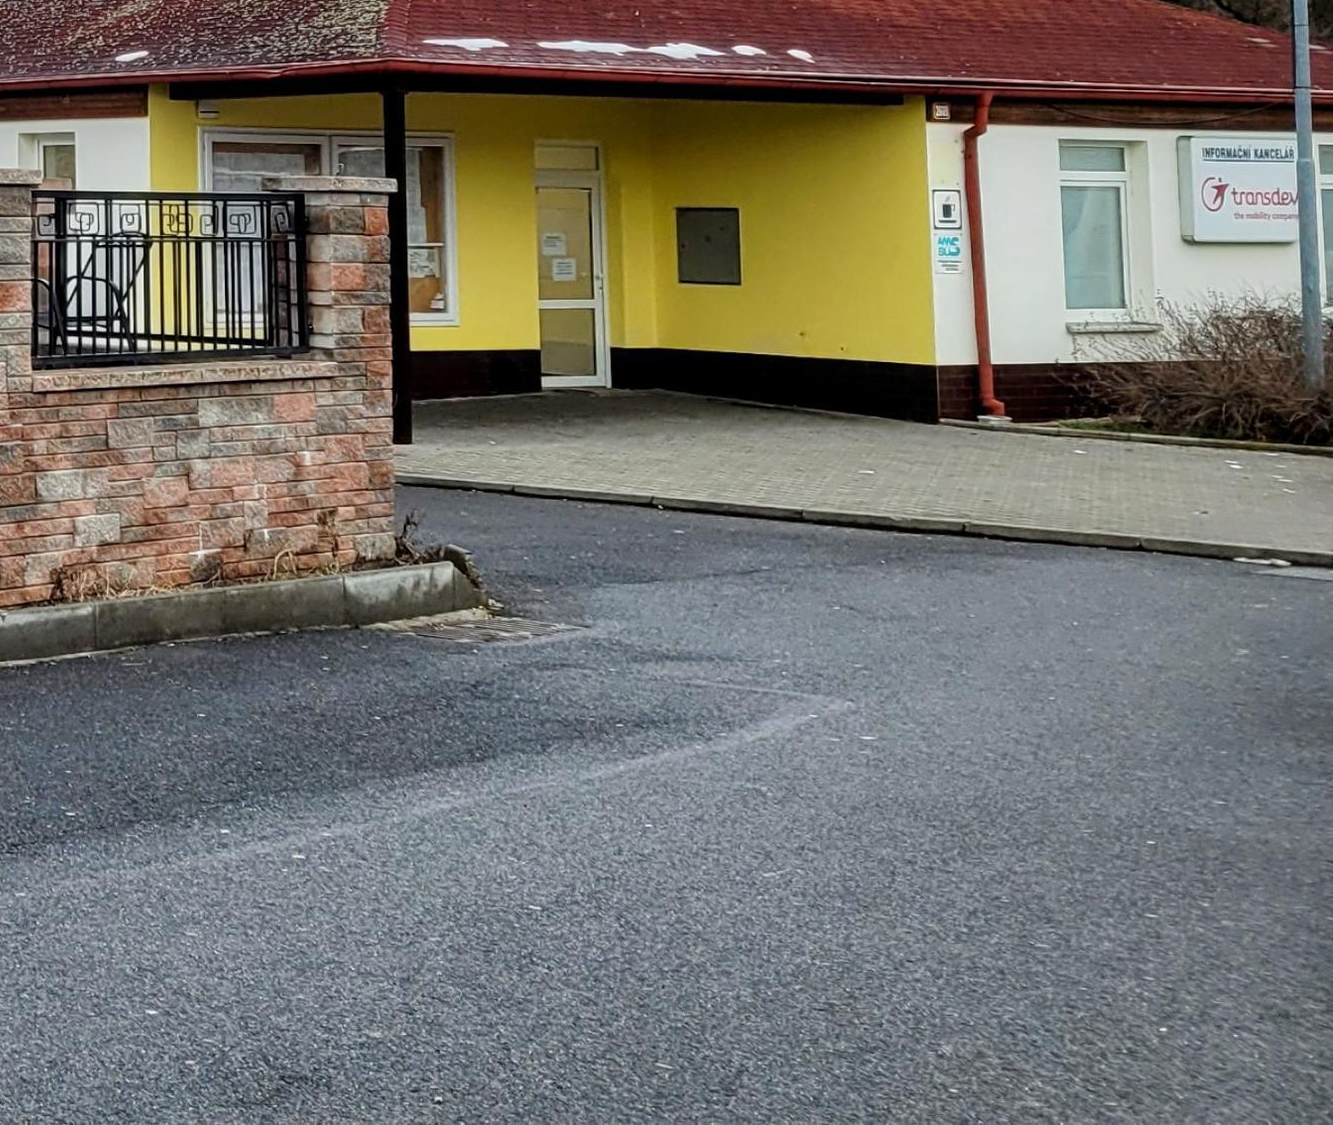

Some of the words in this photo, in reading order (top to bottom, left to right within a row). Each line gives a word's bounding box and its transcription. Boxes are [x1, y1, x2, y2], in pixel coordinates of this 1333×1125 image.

[1202, 145, 1252, 159] INFORMAČNÍ
[1253, 146, 1295, 160] KANCELÁŘ
[1231, 187, 1300, 207] transdev
